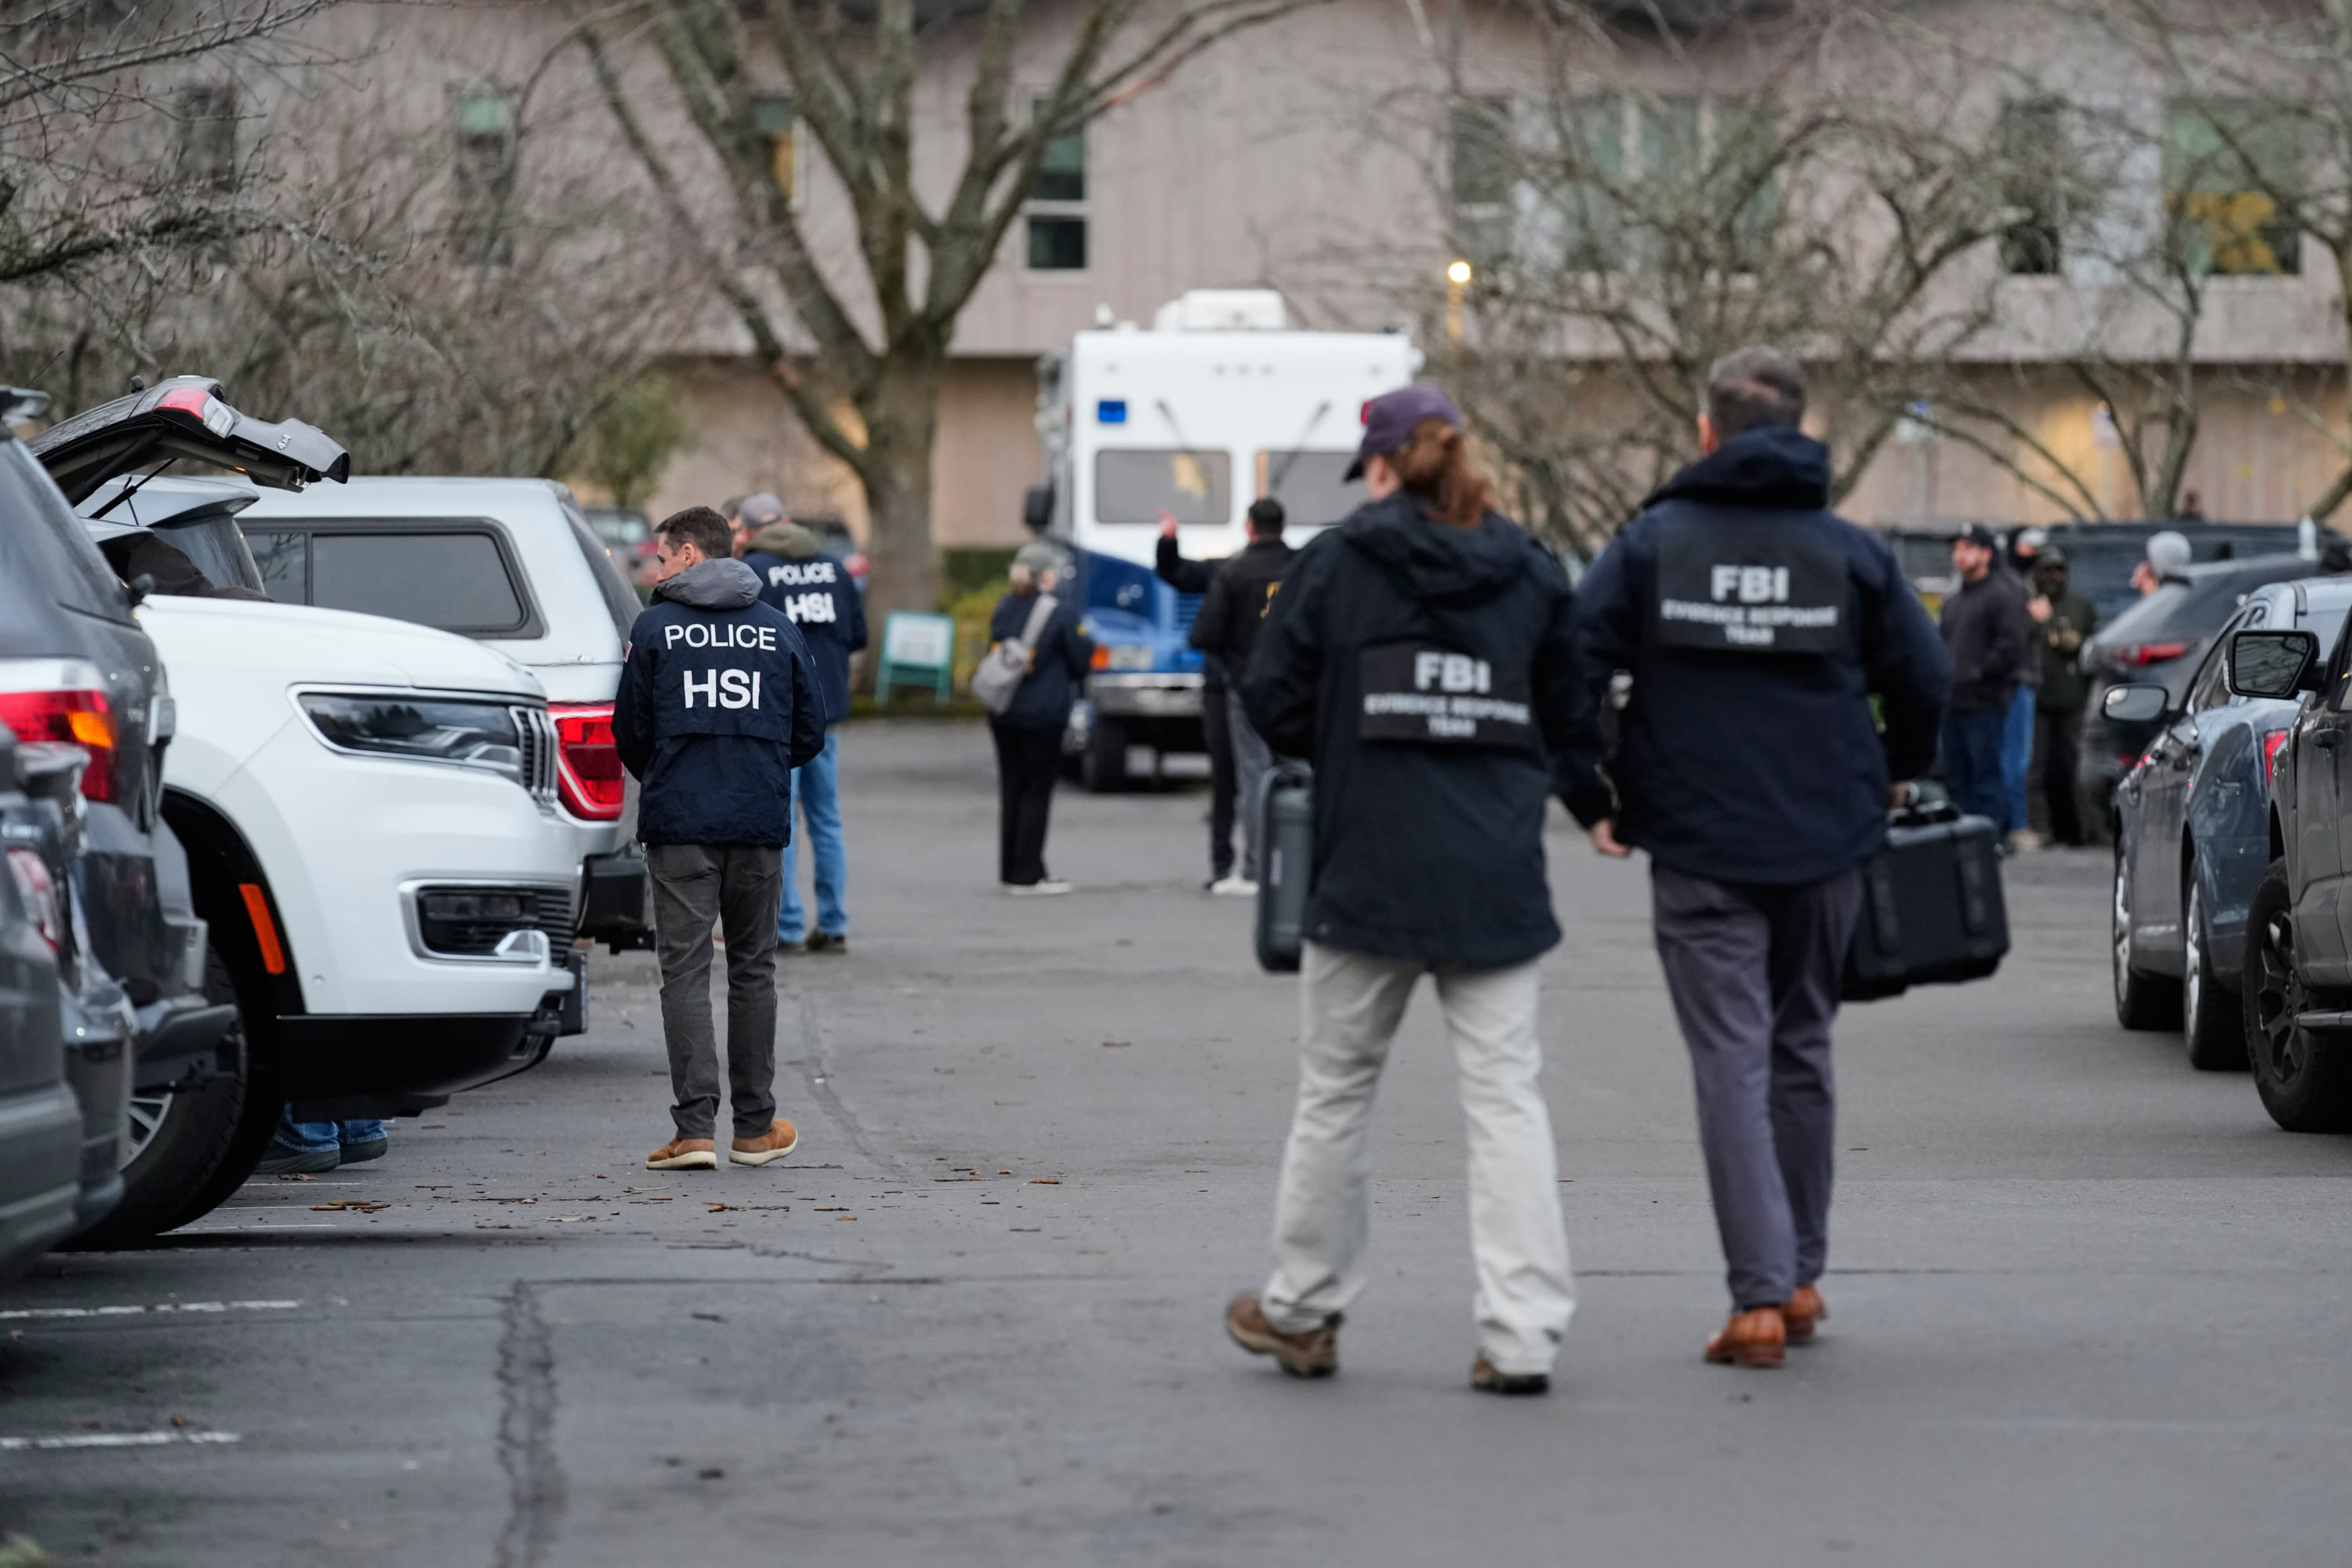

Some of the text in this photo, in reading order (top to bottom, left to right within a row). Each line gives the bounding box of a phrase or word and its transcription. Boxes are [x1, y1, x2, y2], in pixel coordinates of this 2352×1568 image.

[768, 561, 837, 587] POLICE
[1710, 563, 1790, 603] FBI
[784, 592, 837, 624] HSI
[1660, 598, 1838, 627] EVIDENCE RESPONSE
[664, 623, 776, 652] POLICE
[1724, 624, 1775, 644] TEAM
[1414, 651, 1492, 695] FBI
[683, 668, 760, 710] HSI
